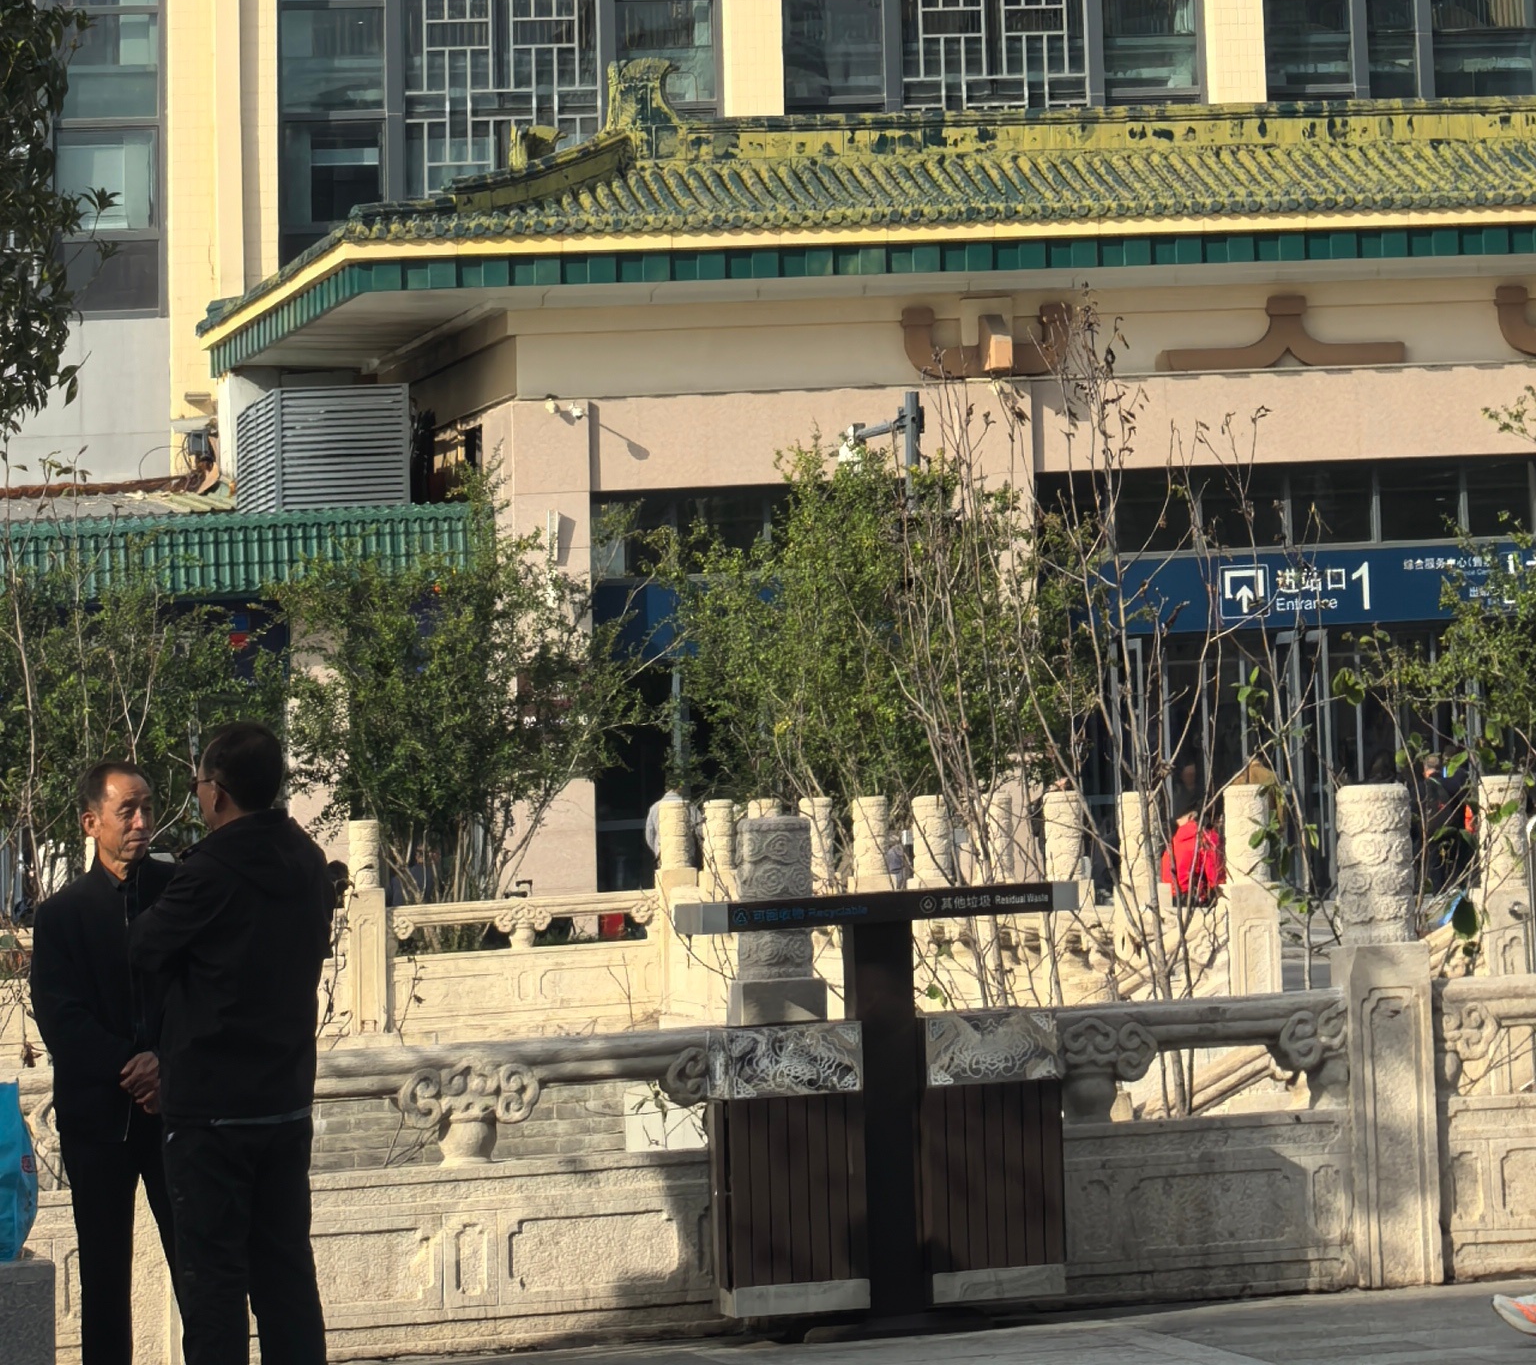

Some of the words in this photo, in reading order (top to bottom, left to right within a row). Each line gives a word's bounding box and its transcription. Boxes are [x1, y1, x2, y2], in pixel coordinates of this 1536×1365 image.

[1275, 567, 1346, 593] 进站口
[1351, 560, 1371, 611] 1
[940, 894, 992, 911] 其他垃圾
[994, 894, 1026, 905] Residual
